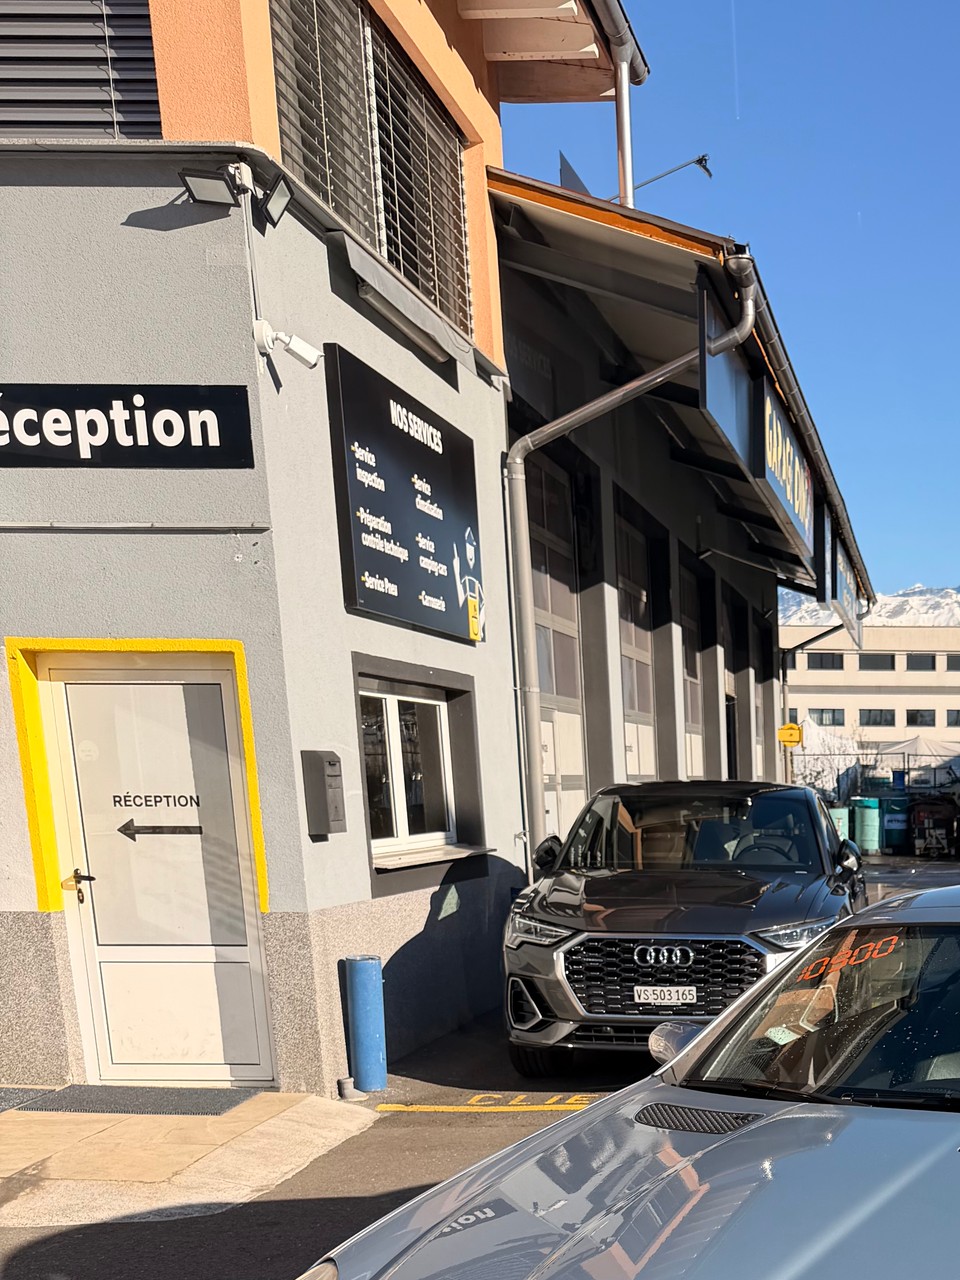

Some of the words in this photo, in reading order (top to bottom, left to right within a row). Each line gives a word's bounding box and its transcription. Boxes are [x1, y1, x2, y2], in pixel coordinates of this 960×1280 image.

[389, 399, 408, 433] NOS
[408, 411, 443, 455] SERVICES
[354, 441, 376, 467] Service
[356, 462, 385, 492] inspection
[363, 571, 385, 593] Service
[112, 791, 201, 808] RÉCEPTION
[675, 989, 695, 1001] 165
[466, 1094, 599, 1105] CLIE
